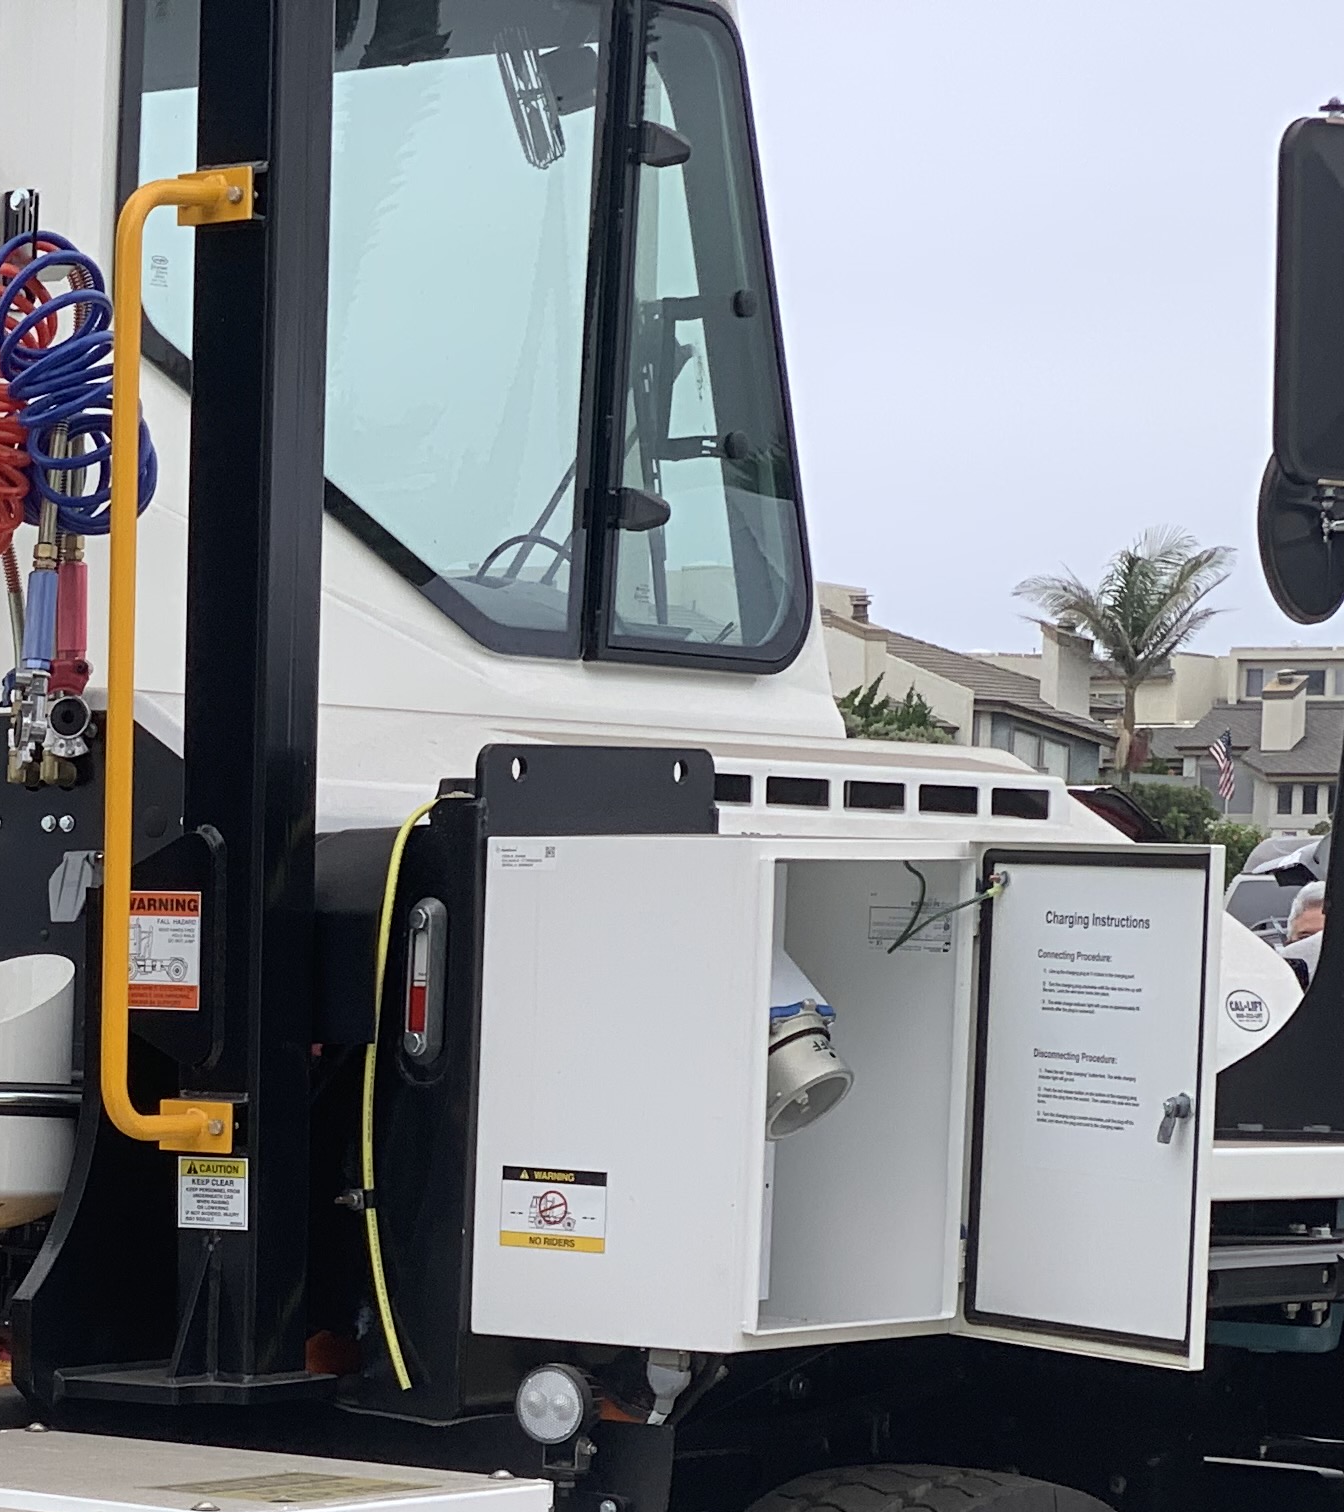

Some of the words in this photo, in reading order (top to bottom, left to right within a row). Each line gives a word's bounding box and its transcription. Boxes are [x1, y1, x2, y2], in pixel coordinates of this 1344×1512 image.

[1045, 910, 1090, 929] Charging
[1092, 913, 1150, 930] Instructions
[1038, 949, 1075, 963] Connecting
[1229, 1000, 1263, 1012] CAL-LIFT
[1033, 1048, 1080, 1063] Disconnecting
[1081, 1052, 1118, 1065] Procedure:
[199, 1163, 239, 1174] CAUTION
[534, 1170, 575, 1182] WARNING
[192, 1178, 210, 1186] KEEP
[211, 1179, 234, 1187] CLEAR
[528, 1236, 542, 1245] NO
[543, 1237, 576, 1248] RIDERS
